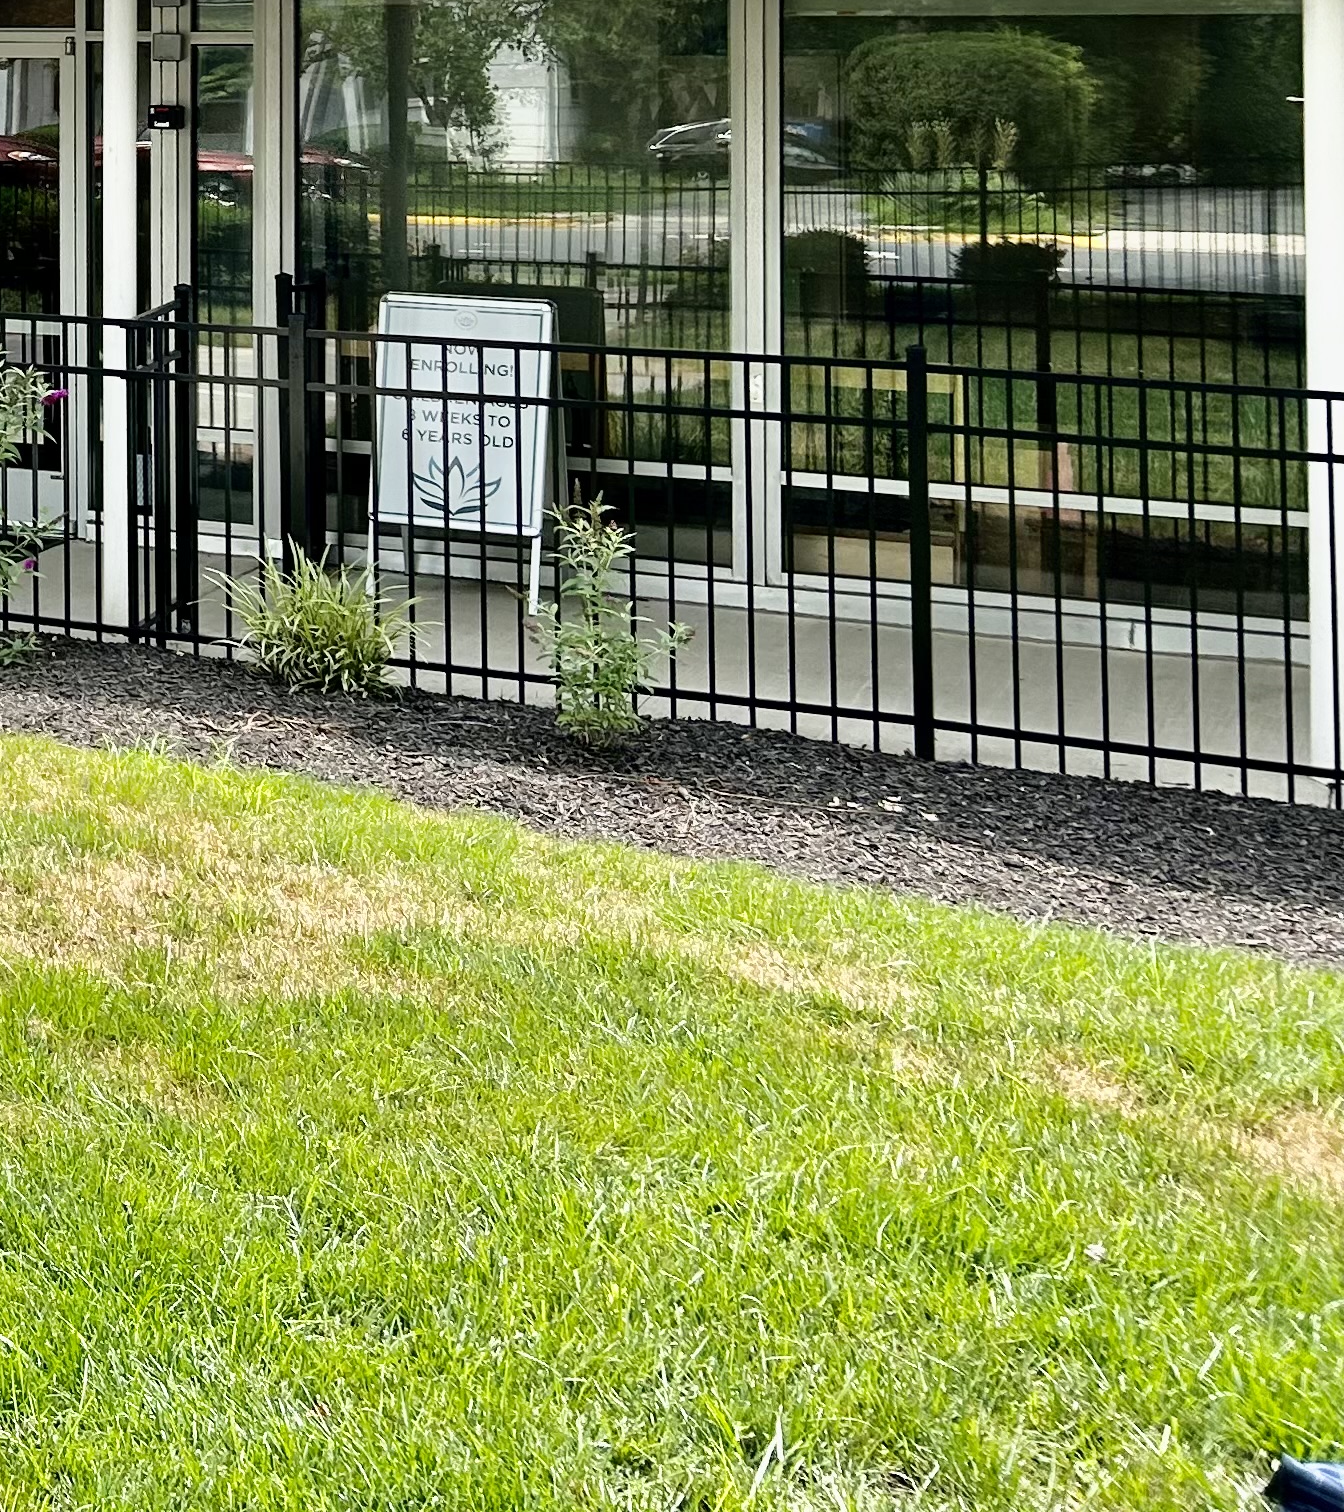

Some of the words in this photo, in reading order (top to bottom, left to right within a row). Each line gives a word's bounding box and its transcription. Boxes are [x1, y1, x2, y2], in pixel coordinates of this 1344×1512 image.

[410, 358, 514, 377] ENROLLNG!
[422, 410, 480, 426] WEKS
[487, 414, 511, 428] TO
[417, 428, 473, 445] YERS
